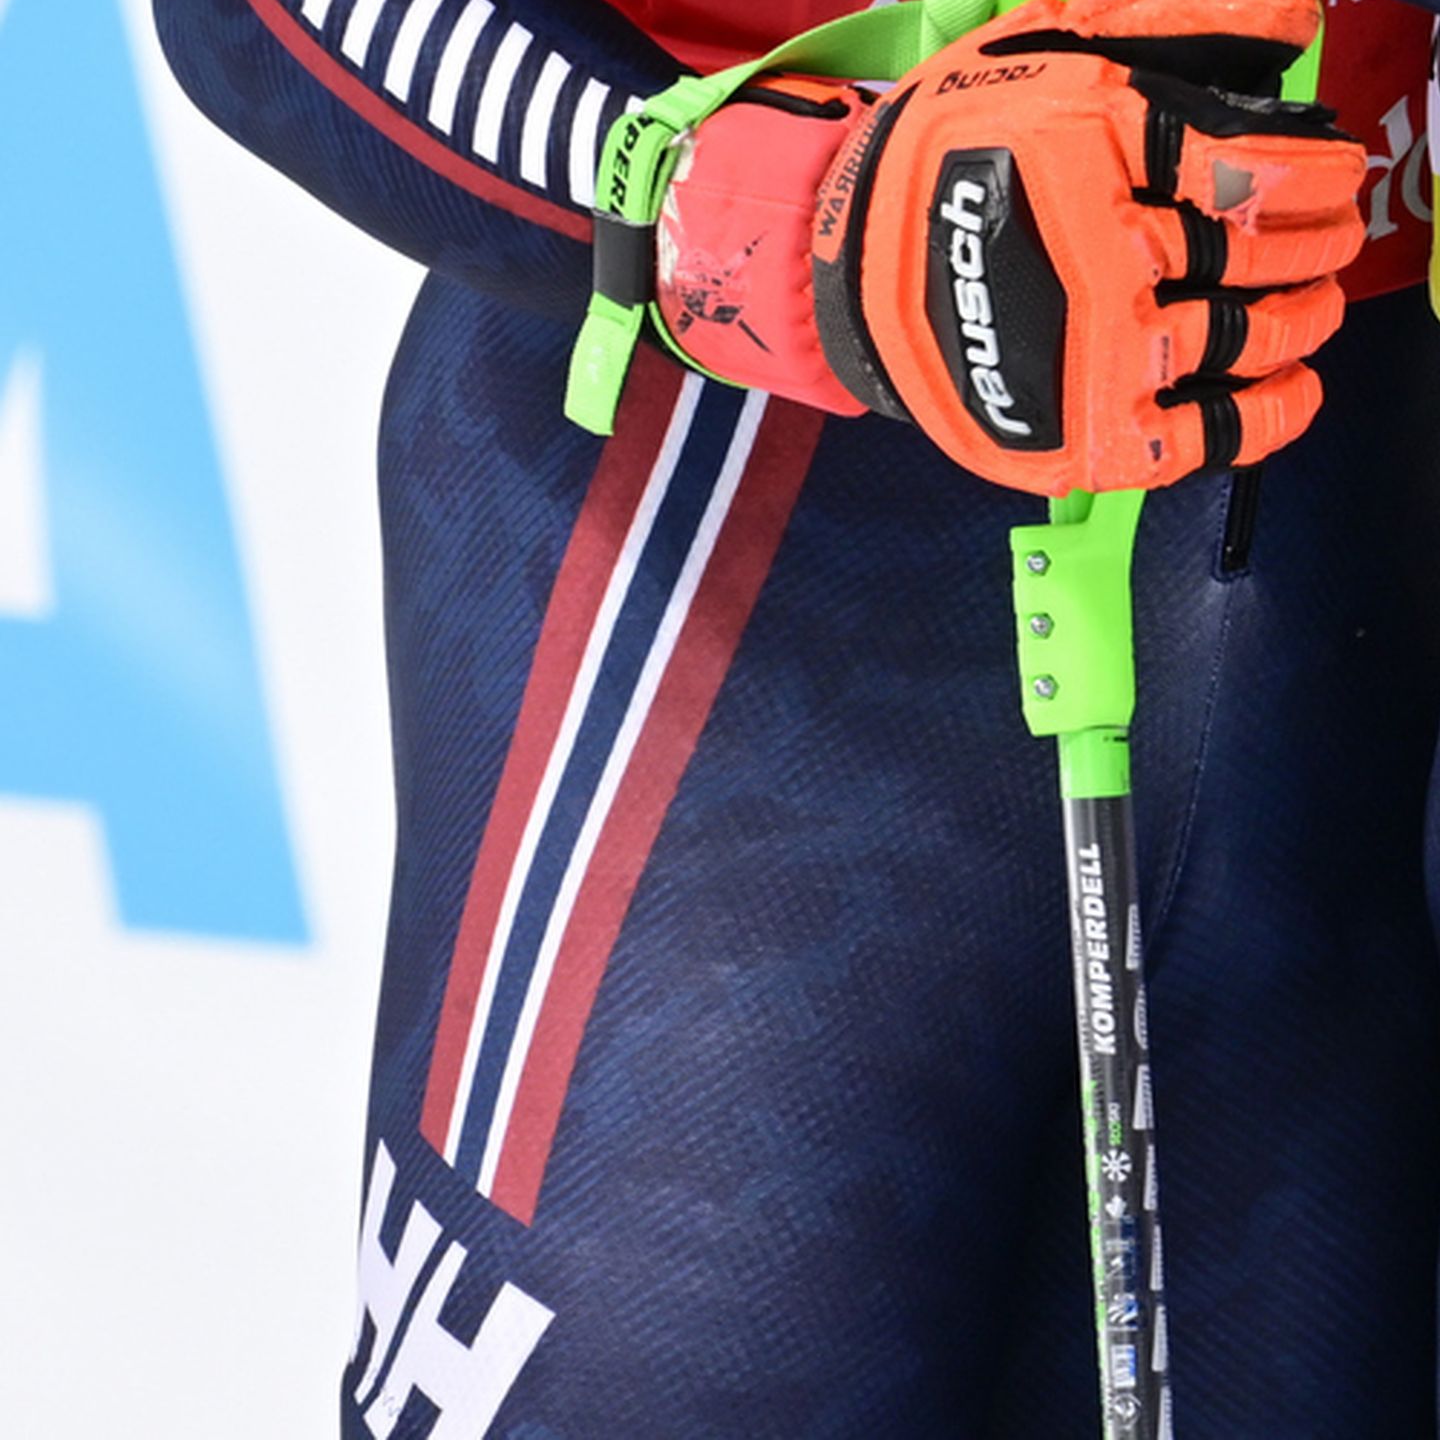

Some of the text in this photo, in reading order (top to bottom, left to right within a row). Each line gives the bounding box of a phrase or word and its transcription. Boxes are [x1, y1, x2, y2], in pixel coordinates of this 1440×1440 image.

[936, 63, 1047, 96] racing
[941, 179, 1033, 436] reusch
[1078, 842, 1117, 1056] KOMPERDELL
